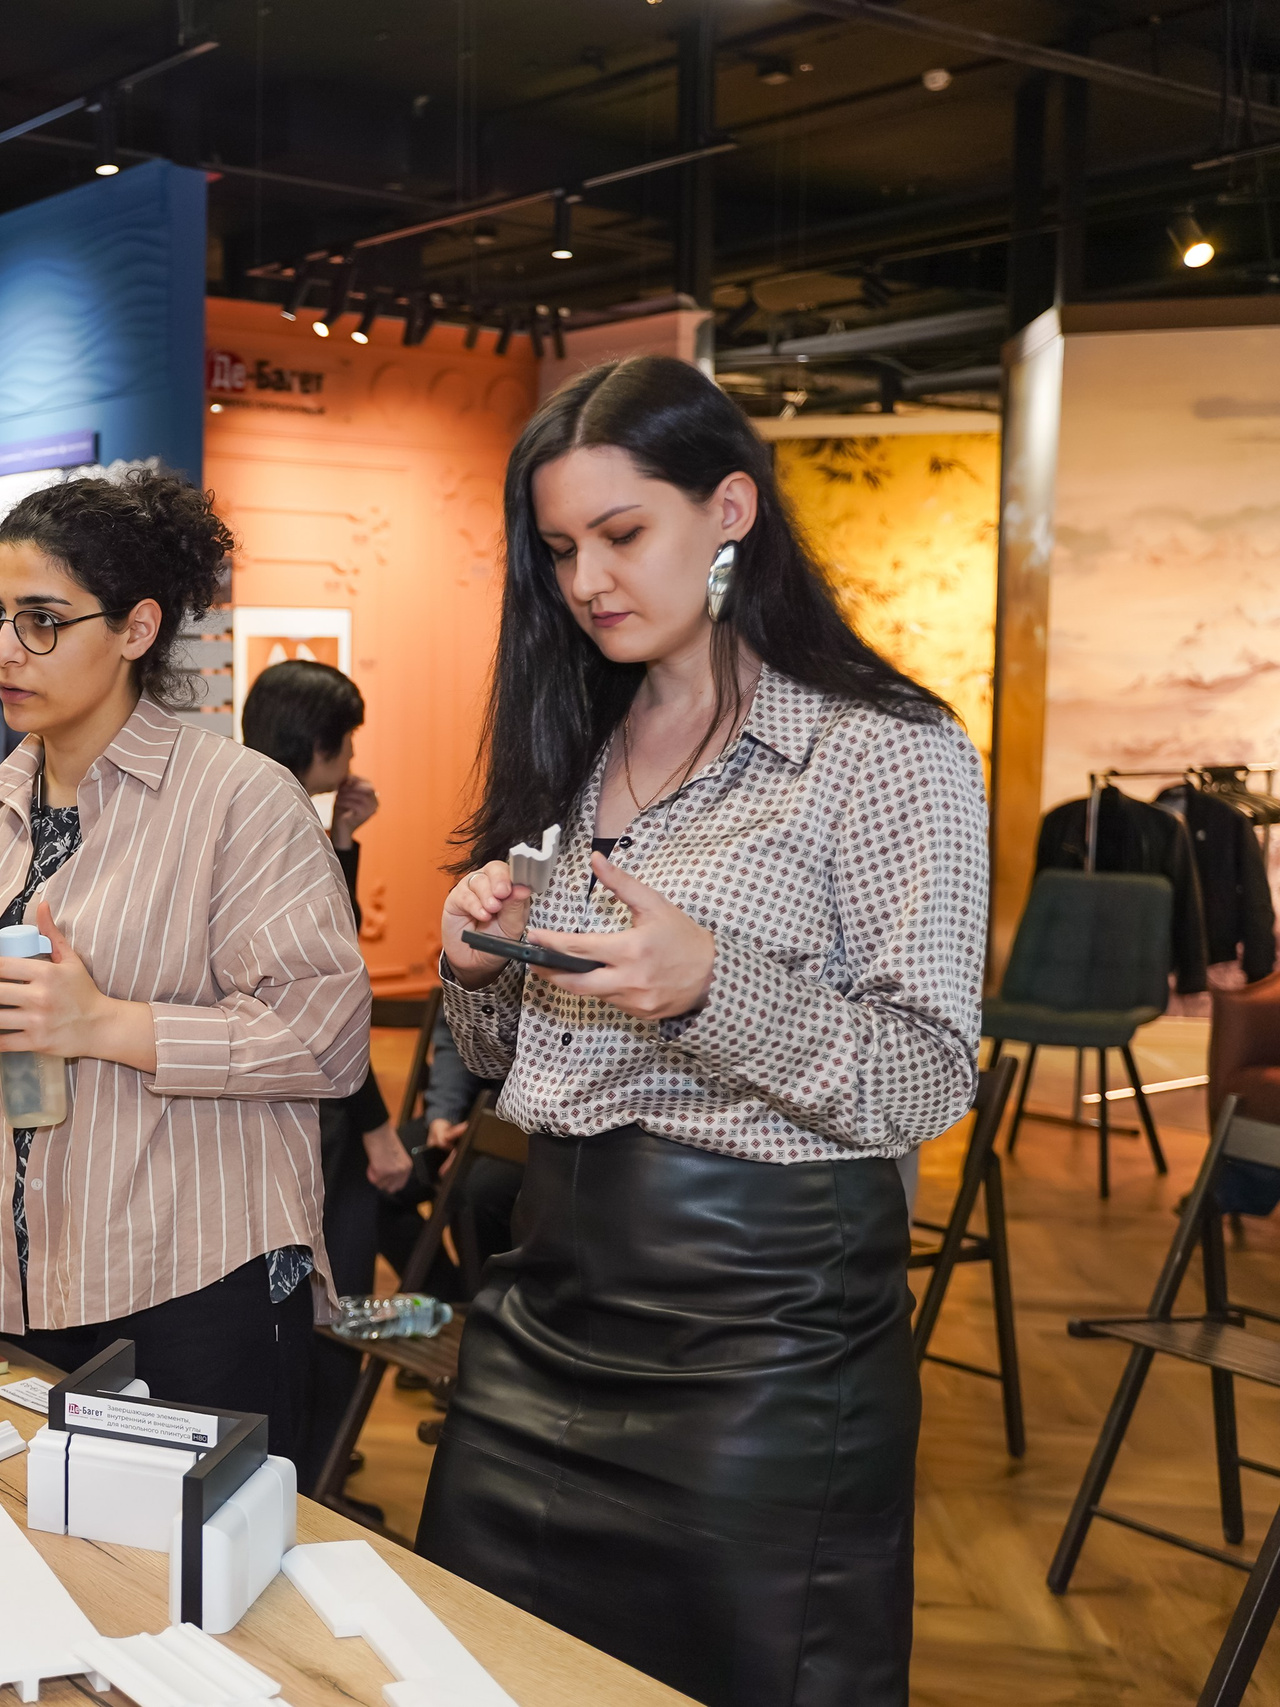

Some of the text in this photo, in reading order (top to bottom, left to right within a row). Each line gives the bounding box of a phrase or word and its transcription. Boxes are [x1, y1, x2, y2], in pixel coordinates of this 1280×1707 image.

[106, 1413, 147, 1424] внутренний
[153, 1420, 185, 1430] внешний
[107, 1404, 191, 1424] Завершающие элементы,
[120, 1423, 160, 1435] напольного
[160, 1430, 191, 1439] плинтуса
